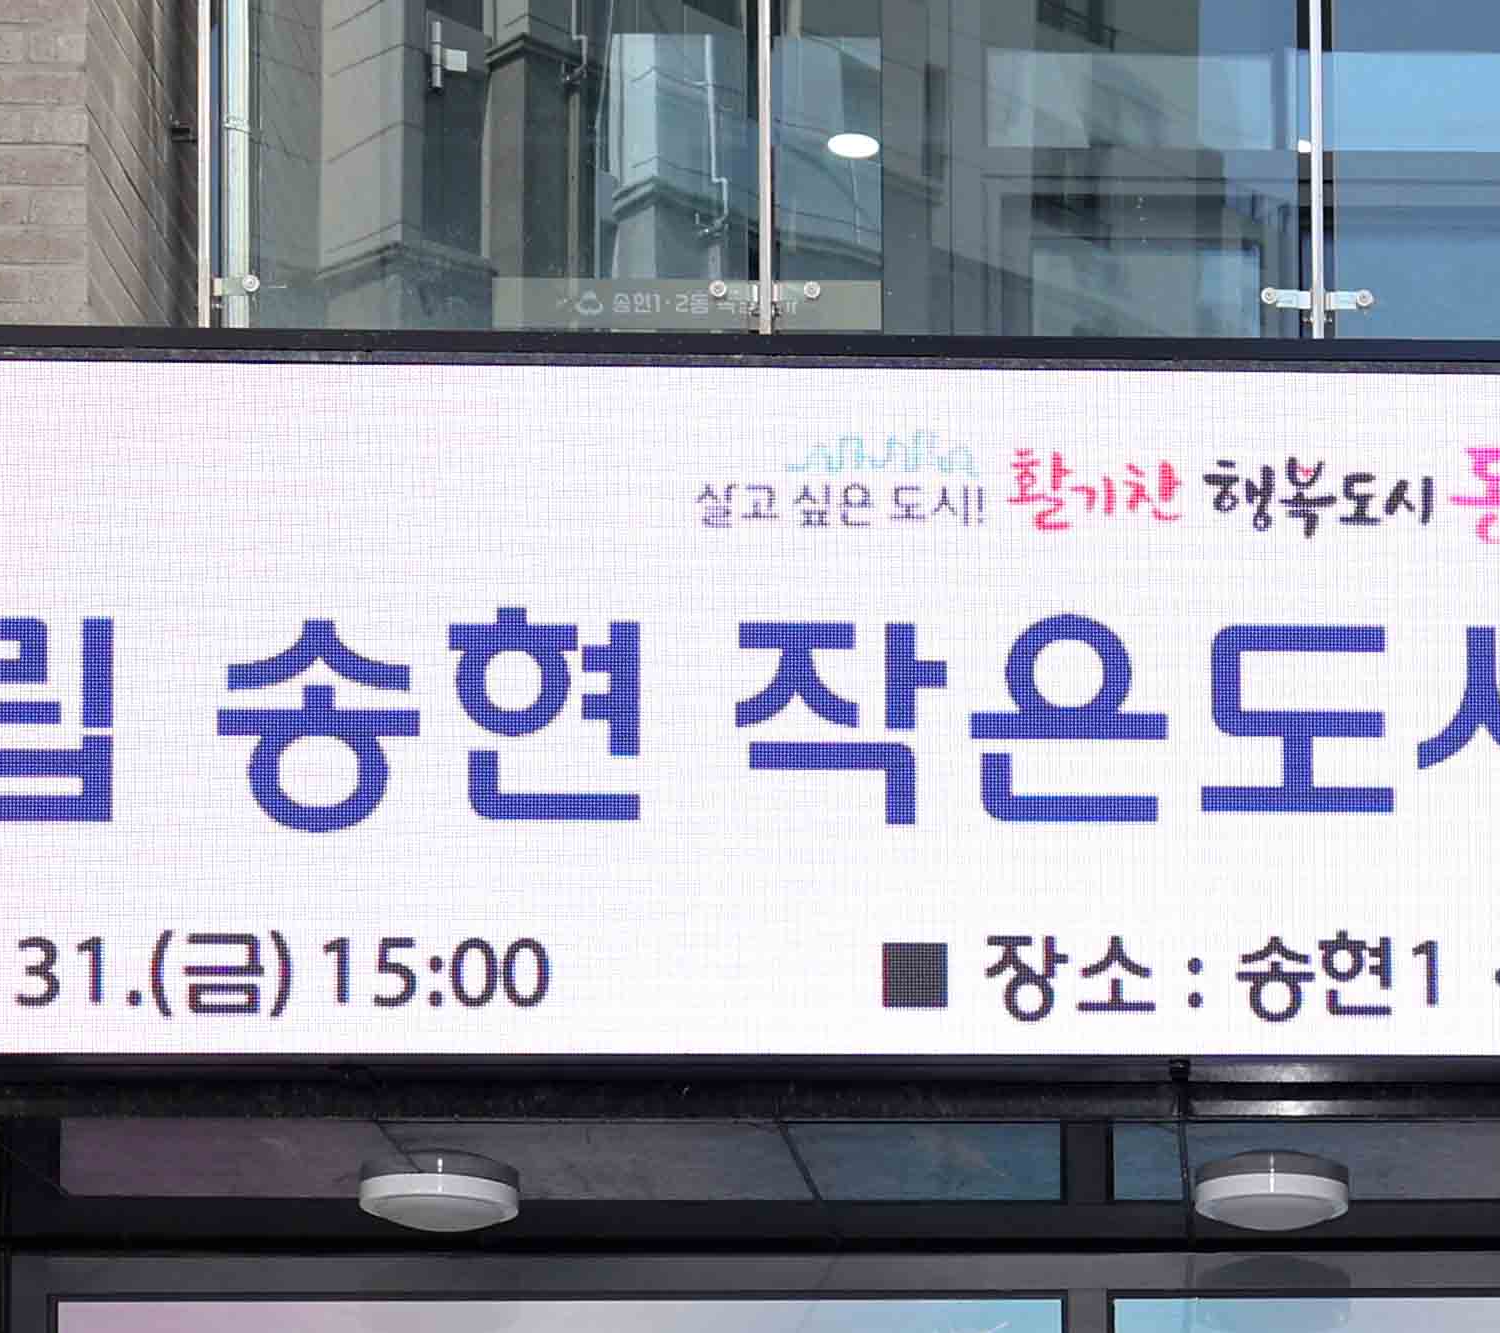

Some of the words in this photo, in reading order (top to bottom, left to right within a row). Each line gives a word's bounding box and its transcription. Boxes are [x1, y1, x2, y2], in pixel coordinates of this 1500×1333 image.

[696, 482, 777, 528] 살고
[794, 482, 872, 529] 싶은
[891, 484, 986, 526] 도시!
[1006, 447, 1183, 533] 활기찬
[1200, 454, 1436, 541] 행복도시
[217, 606, 640, 833] 송현
[322, 936, 551, 1008] 15:00
[985, 934, 1157, 1023] 장소
